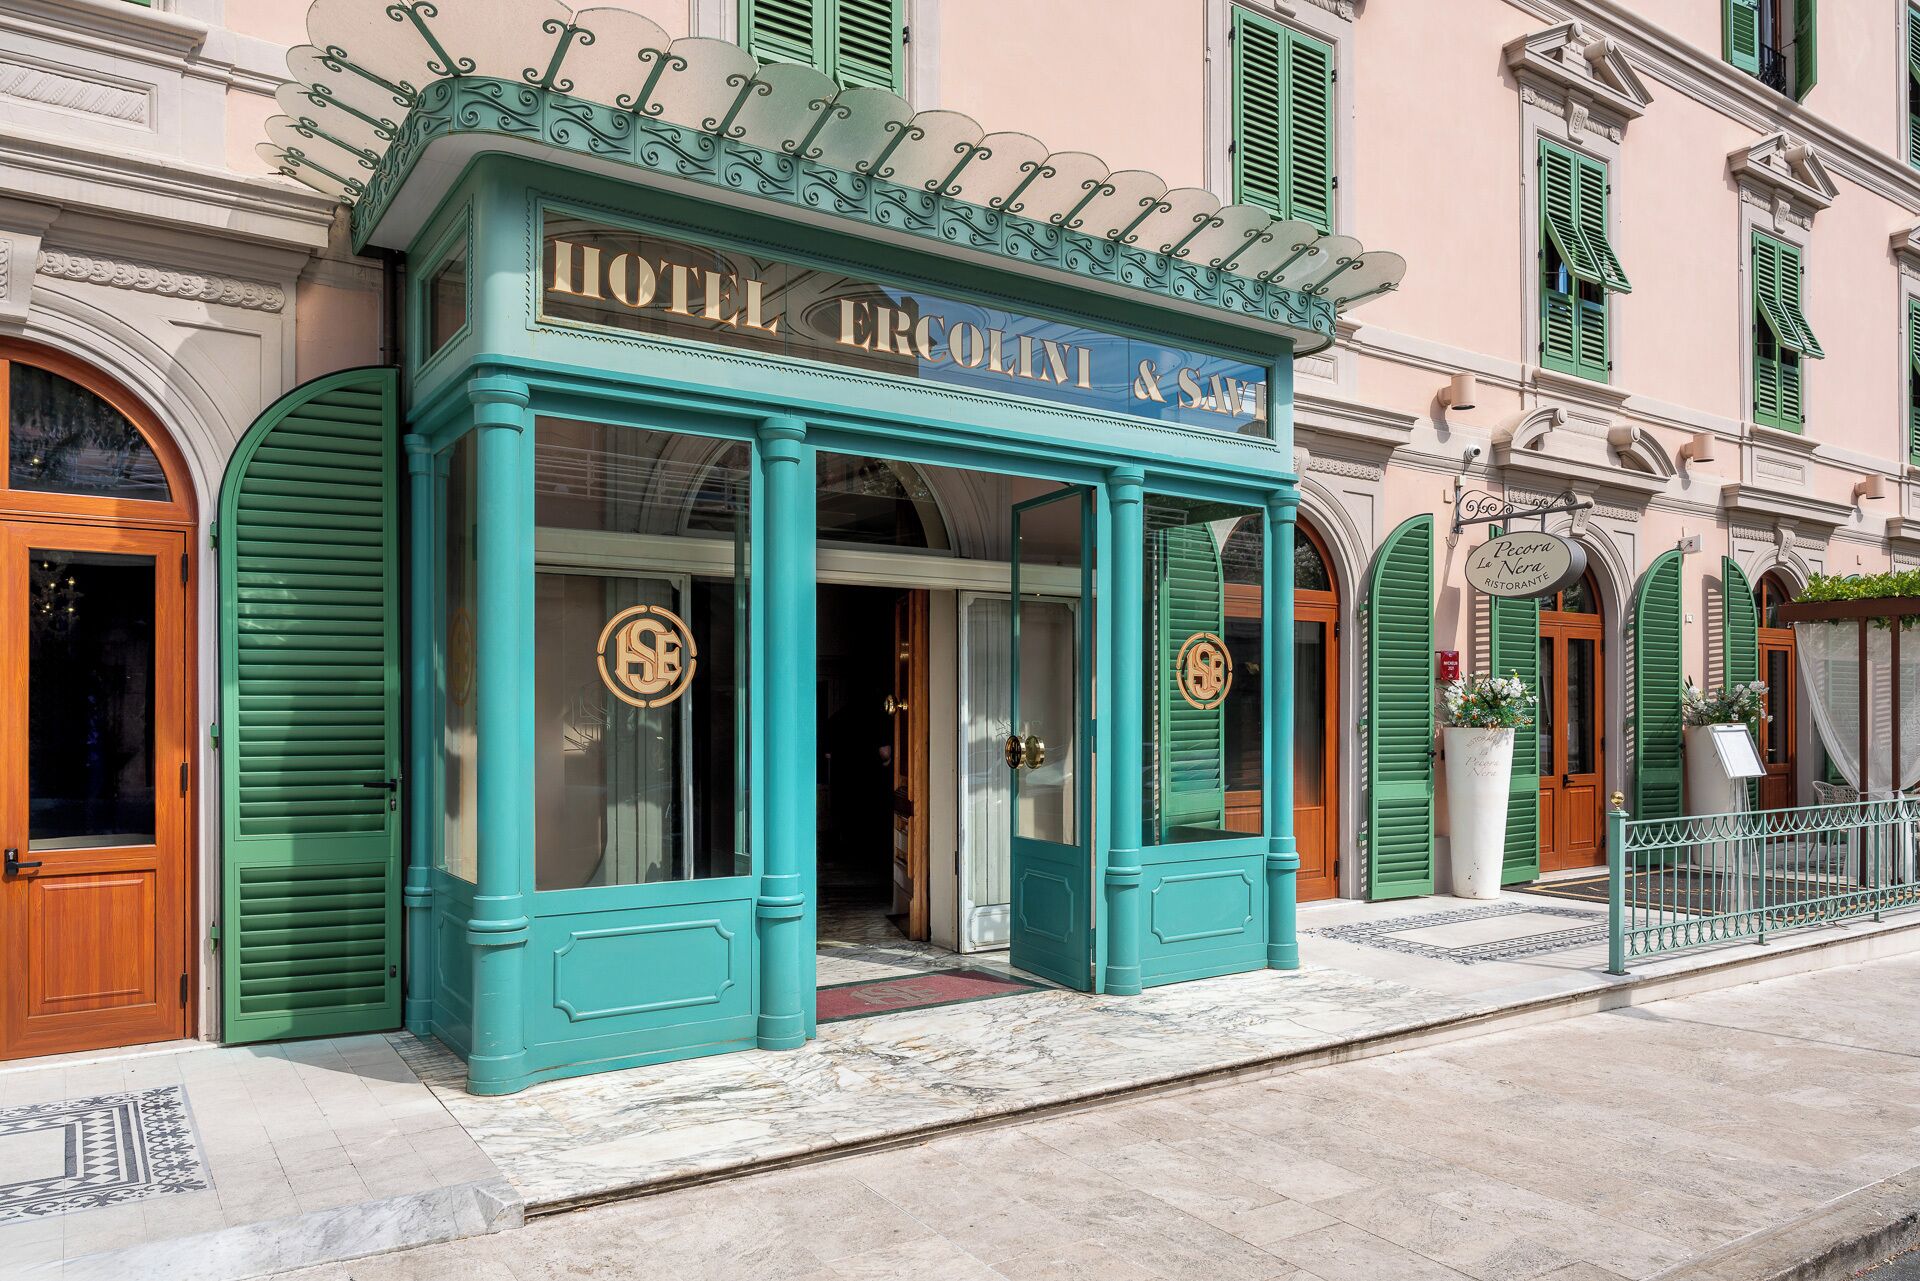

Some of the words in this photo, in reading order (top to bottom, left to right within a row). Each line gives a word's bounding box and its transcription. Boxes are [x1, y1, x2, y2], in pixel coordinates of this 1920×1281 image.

[548, 239, 778, 335] HOTEL
[836, 298, 1094, 391] ERCOLINI
[1133, 358, 1168, 404] &
[1177, 367, 1267, 422] SAVI
[1493, 540, 1555, 559] Pecora
[1476, 557, 1493, 570] La
[1497, 557, 1546, 579] Nera
[1484, 571, 1550, 591] RISTORANTE
